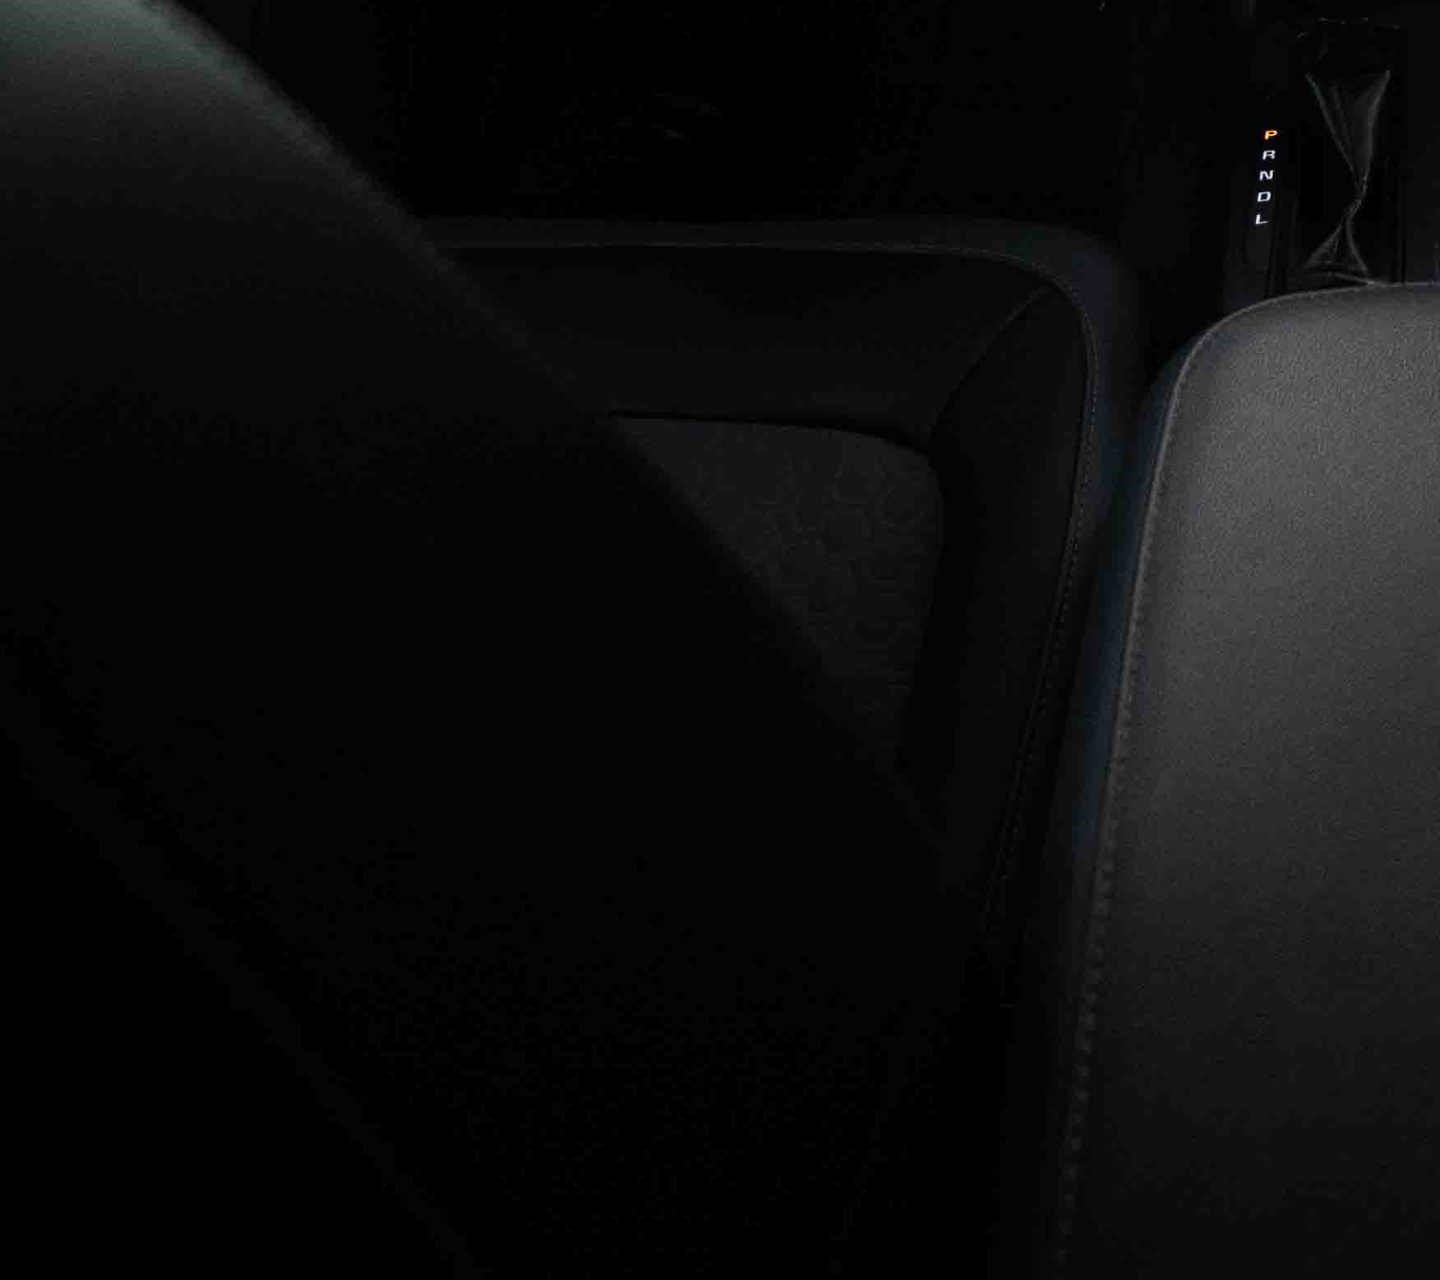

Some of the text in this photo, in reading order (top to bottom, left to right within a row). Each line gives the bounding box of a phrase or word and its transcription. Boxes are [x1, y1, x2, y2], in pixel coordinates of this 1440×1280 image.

[1264, 129, 1279, 141] P
[1262, 149, 1276, 160] R
[1259, 170, 1275, 181] N
[1257, 191, 1272, 203] D
[1255, 213, 1271, 225] L
